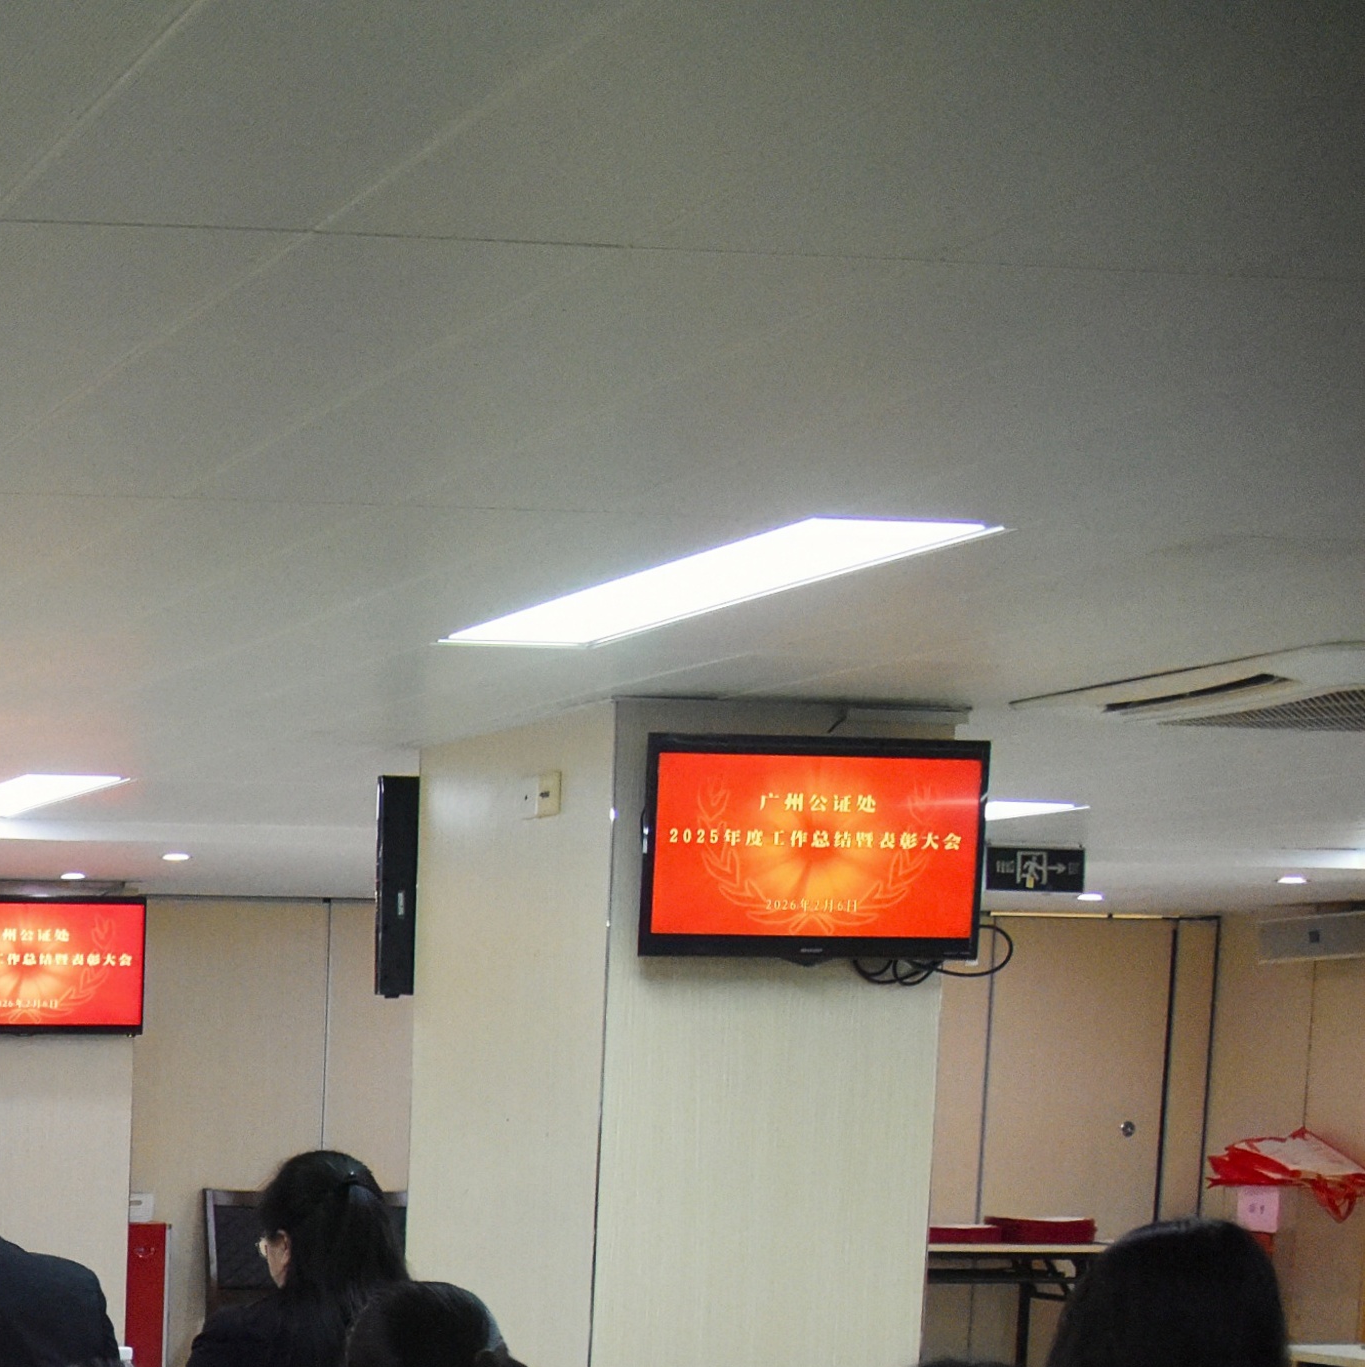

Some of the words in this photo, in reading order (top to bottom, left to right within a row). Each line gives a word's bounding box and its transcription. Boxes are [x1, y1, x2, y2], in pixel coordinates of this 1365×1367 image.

[759, 794, 877, 814] 广州公证处
[669, 828, 962, 851] 2025年度工作总结暨表彰大会
[765, 898, 858, 913] 2026年2月6日
